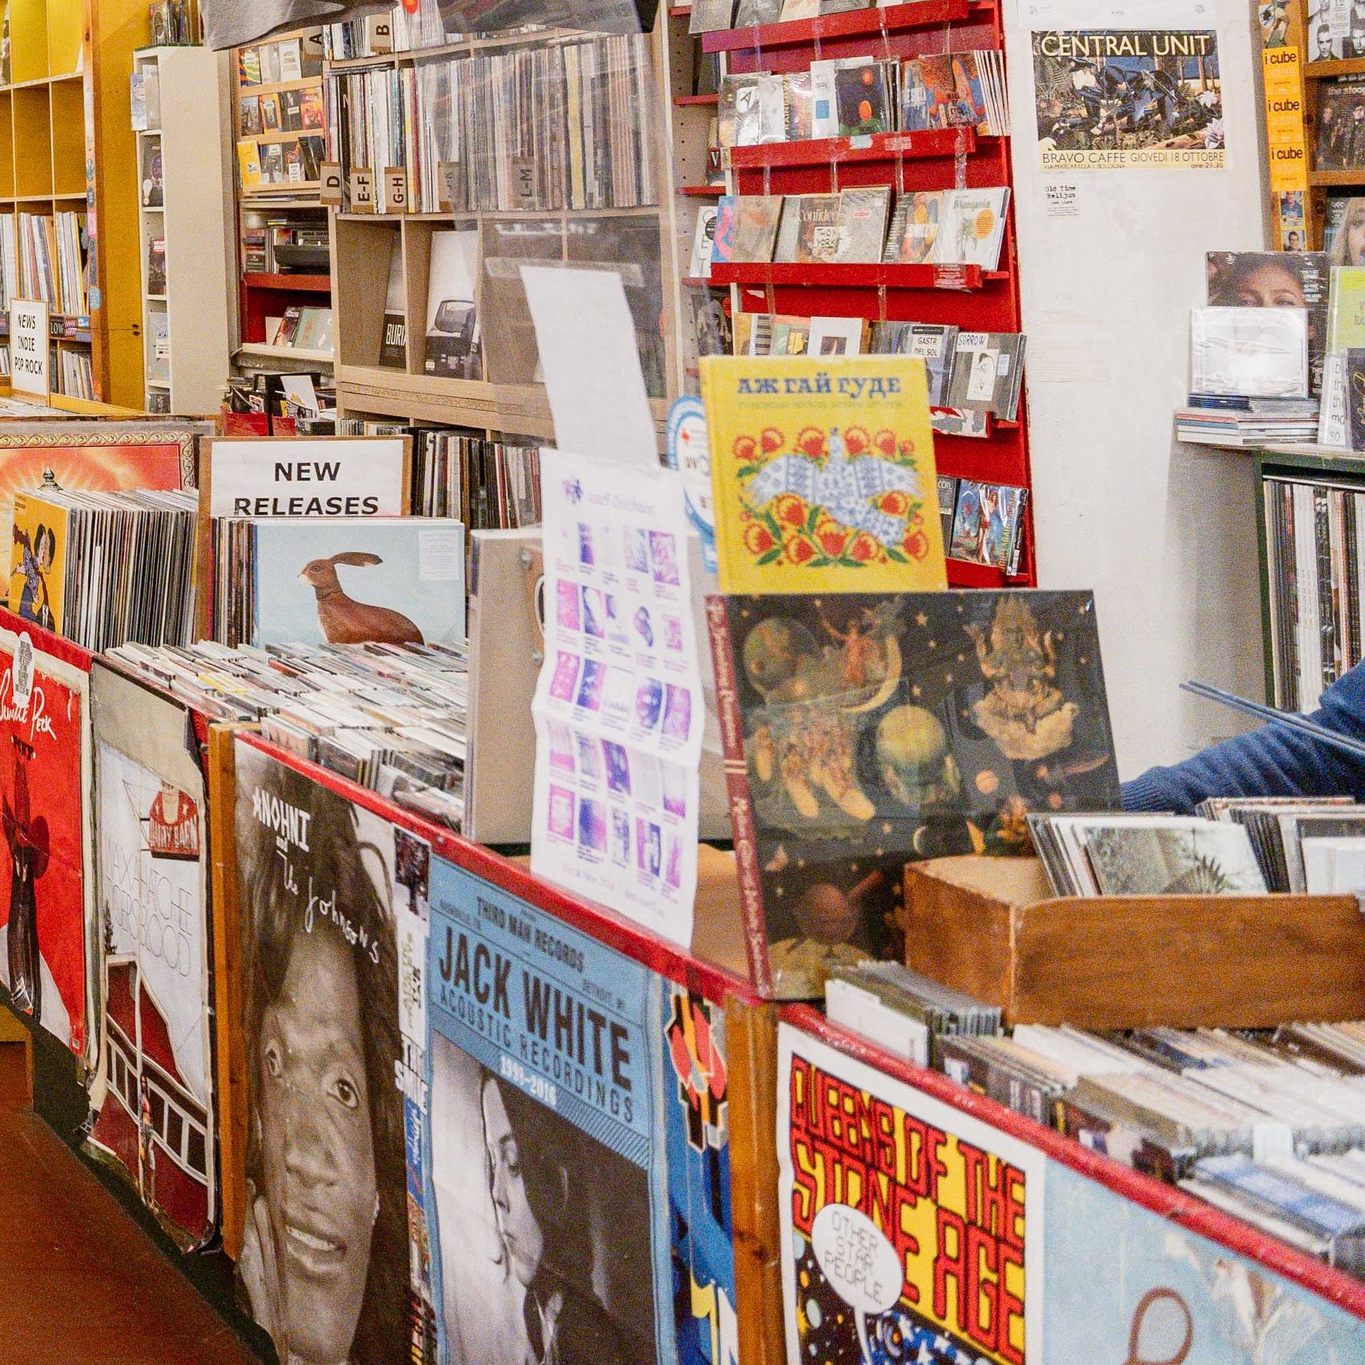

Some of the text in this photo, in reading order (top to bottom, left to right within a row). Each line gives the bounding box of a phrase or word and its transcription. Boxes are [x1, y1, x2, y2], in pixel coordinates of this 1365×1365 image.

[309, 33, 323, 46] A
[376, 24, 390, 36] B
[1040, 35, 1210, 56] CENTRAL UNIT
[1270, 51, 1298, 64] cube
[1273, 99, 1300, 112] cube
[1042, 152, 1085, 164] BRAVO
[1170, 152, 1181, 163] 18
[1182, 151, 1224, 162] OTTOBRE
[1276, 147, 1304, 161] cube
[326, 174, 340, 188] D
[357, 175, 371, 202] E-F
[392, 176, 405, 204] G-H
[18, 313, 36, 330] NEWS
[18, 336, 36, 352] INDIE
[917, 336, 938, 346] GASTR
[914, 348, 938, 356] DEL SOL
[14, 356, 43, 376] POP ROCK
[737, 372, 901, 399] АЖ ГАЙ ГУДЕ
[274, 462, 341, 482] NEW
[234, 496, 379, 515] RELEASES
[476, 896, 585, 974] THIRD MAN RECORDS
[438, 925, 512, 1021] JACK
[522, 969, 632, 1094] WHITE
[439, 984, 634, 1124] ACOUSTIC RECORDINGS
[789, 1054, 1027, 1251] QUEENS OF THE
[831, 1204, 880, 1254] OTHER
[791, 1131, 1027, 1364] STONE AGE
[834, 1231, 876, 1278] STAR
[823, 1249, 884, 1305] PEOPLE
